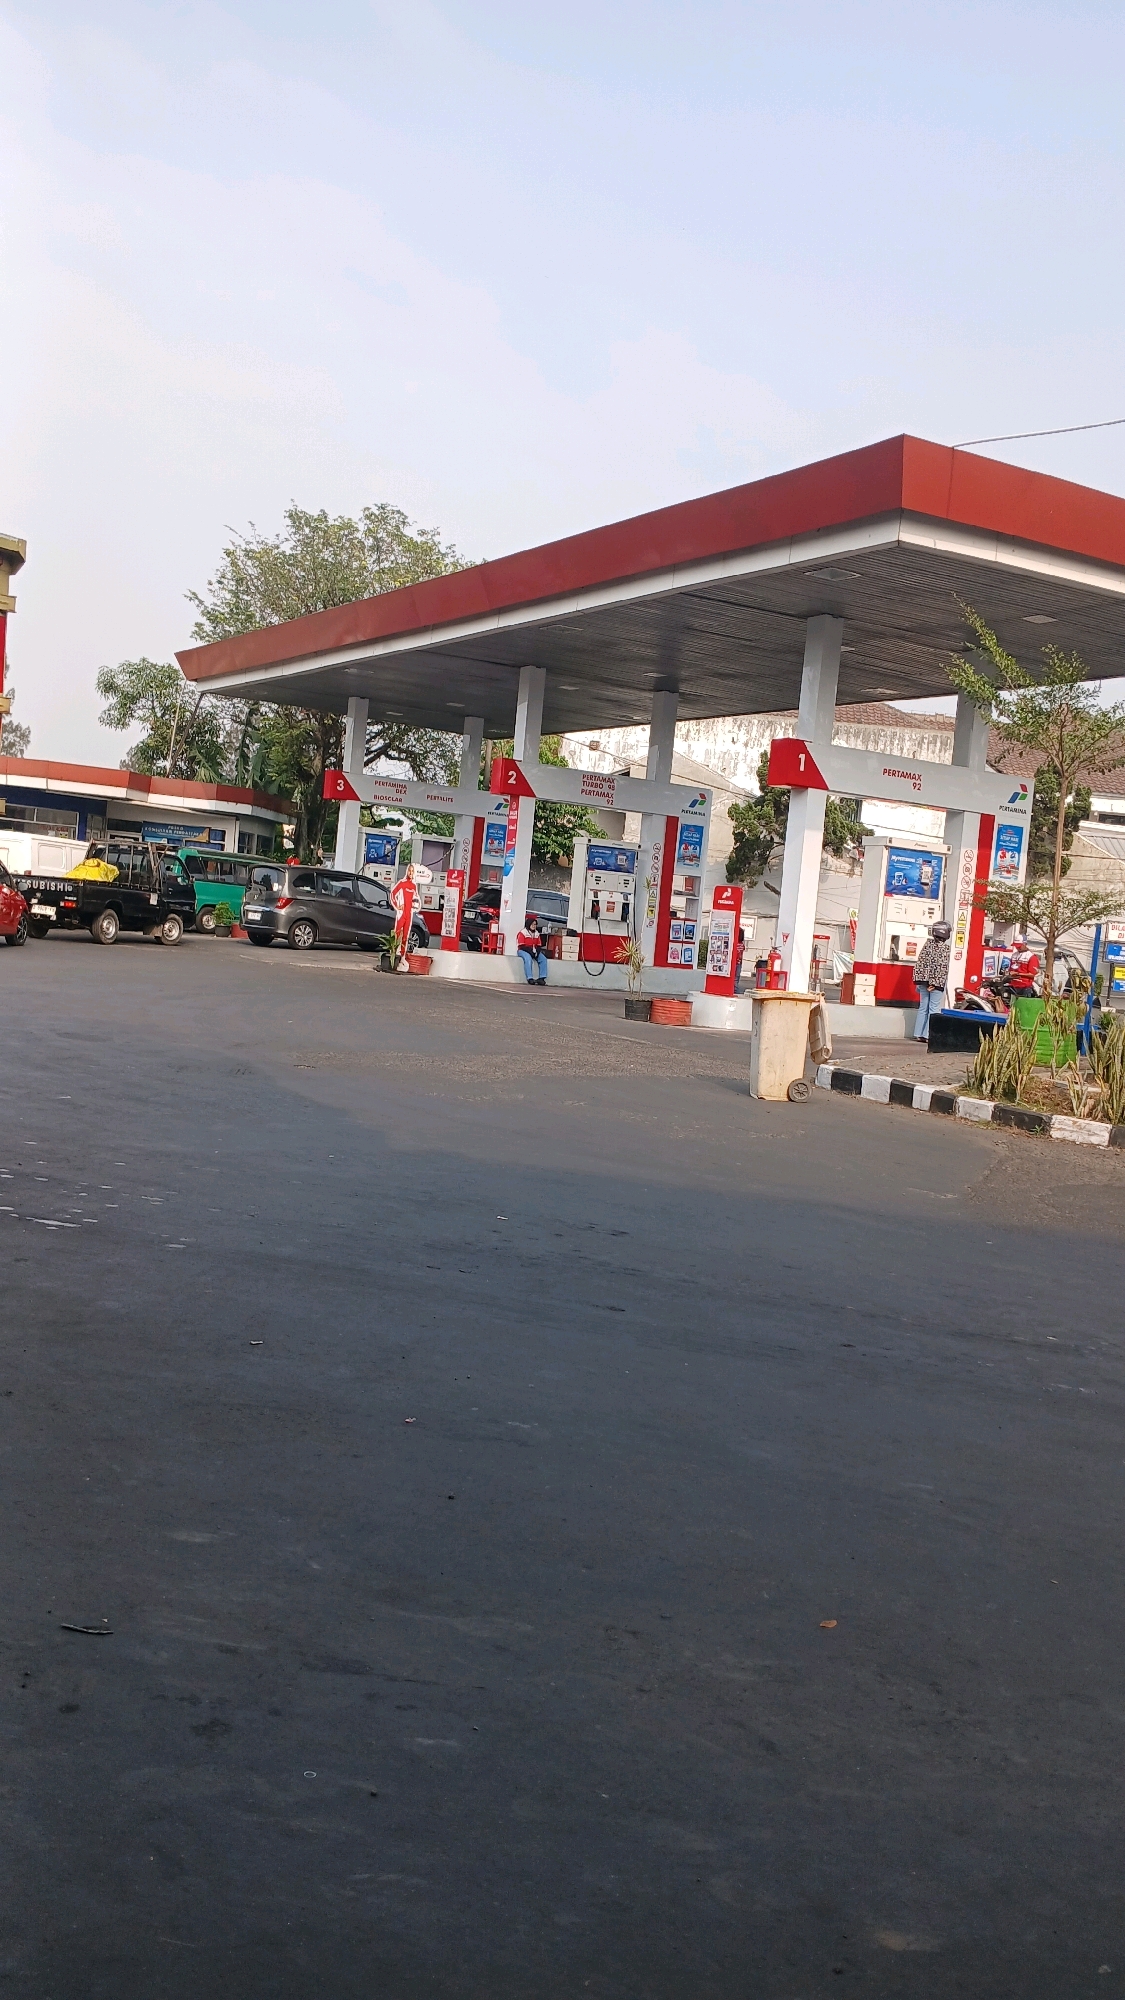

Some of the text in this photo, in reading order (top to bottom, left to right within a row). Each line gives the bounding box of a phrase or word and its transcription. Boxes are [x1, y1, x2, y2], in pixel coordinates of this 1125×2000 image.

[798, 753, 806, 772] 1
[507, 770, 517, 785] 2
[582, 774, 616, 784] PERTAMAX
[882, 768, 923, 782] PERTAMAX
[336, 779, 345, 791] 3
[374, 780, 408, 790] PERTAMINA
[582, 781, 604, 790] TURBO
[912, 781, 922, 791] 92
[426, 794, 454, 803] PERTALITE
[580, 788, 615, 799] PERTAMAX
[681, 808, 706, 817] PERTAMINA
[998, 805, 1027, 815] PERTAMINA
[12, 879, 68, 892] SUBISHI
